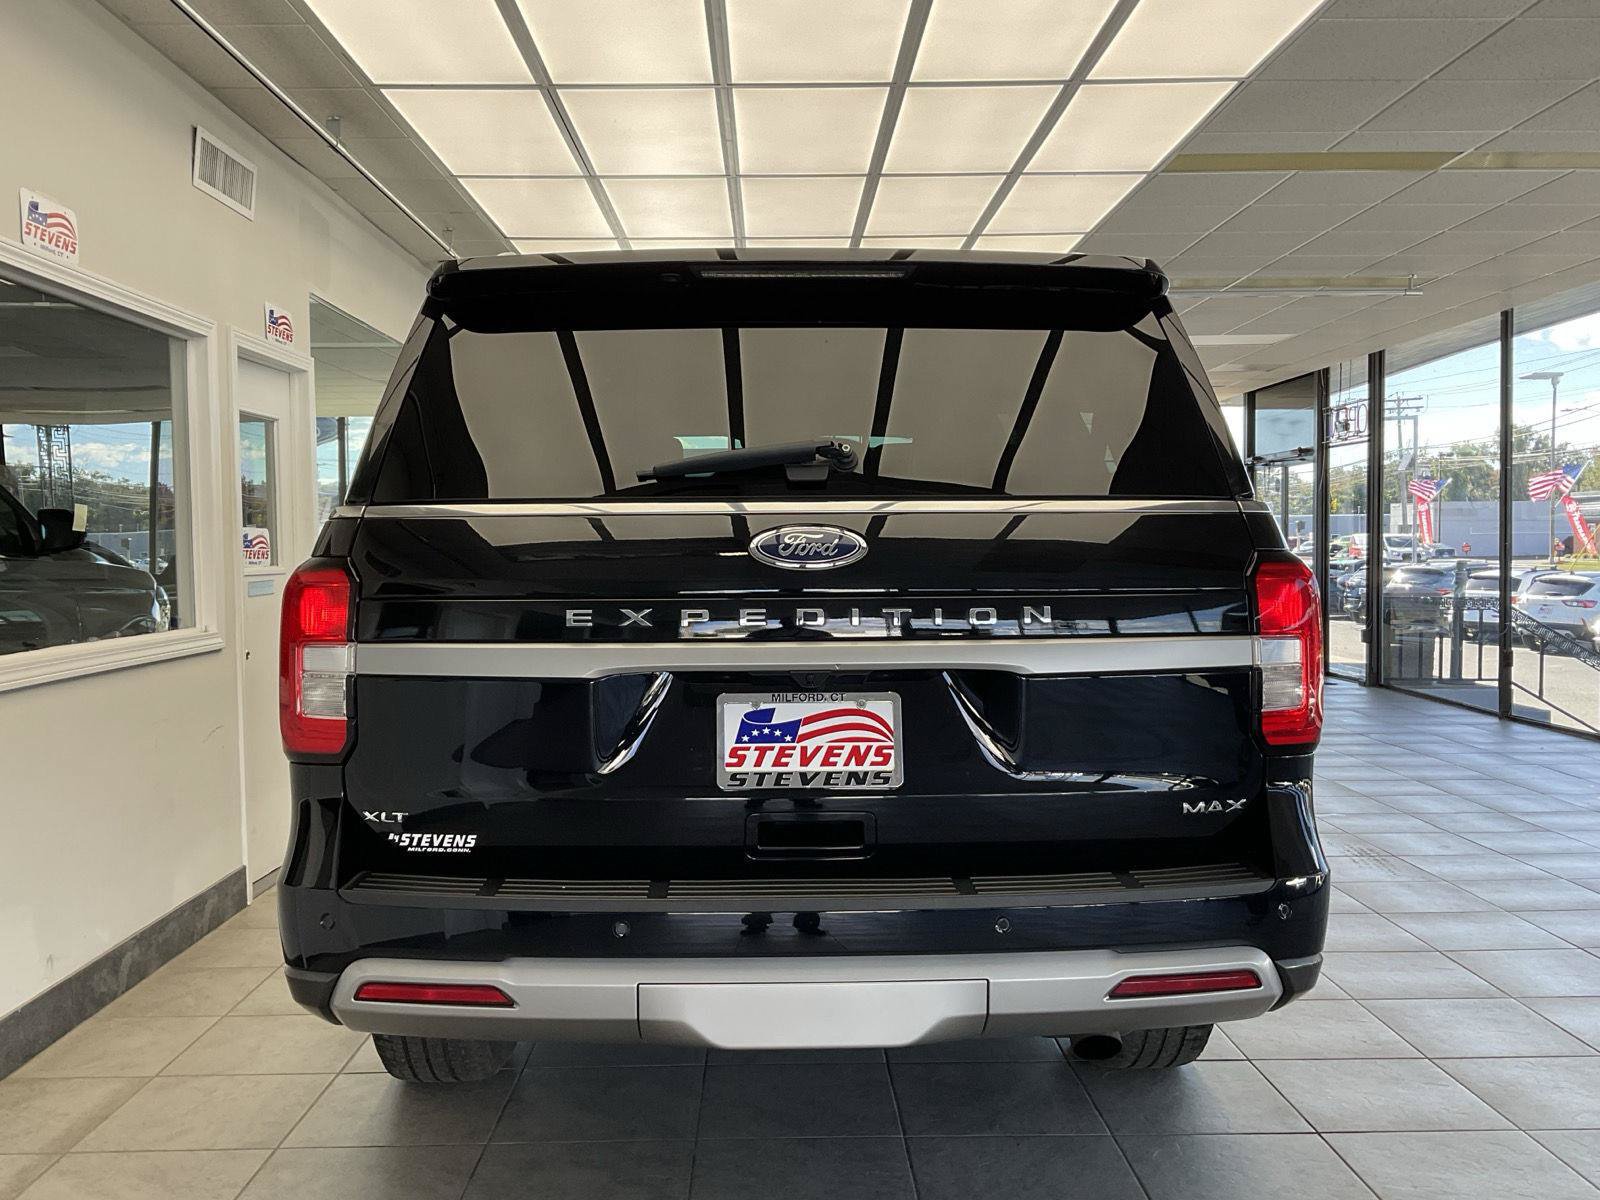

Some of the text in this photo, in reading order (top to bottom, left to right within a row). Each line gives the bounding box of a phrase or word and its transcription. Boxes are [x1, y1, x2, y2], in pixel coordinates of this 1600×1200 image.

[24, 221, 77, 254] STEVENS
[267, 323, 293, 343] STEVENS
[778, 533, 840, 557] Ford
[242, 549, 270, 560] TEVENS
[565, 605, 1053, 628] EXPEDITION
[830, 693, 846, 702] CT
[725, 744, 894, 768] STEVENS
[727, 770, 893, 787] STEVENS
[1182, 798, 1247, 814] MAX
[362, 810, 409, 823] XLT
[399, 833, 477, 848] STEVENS
